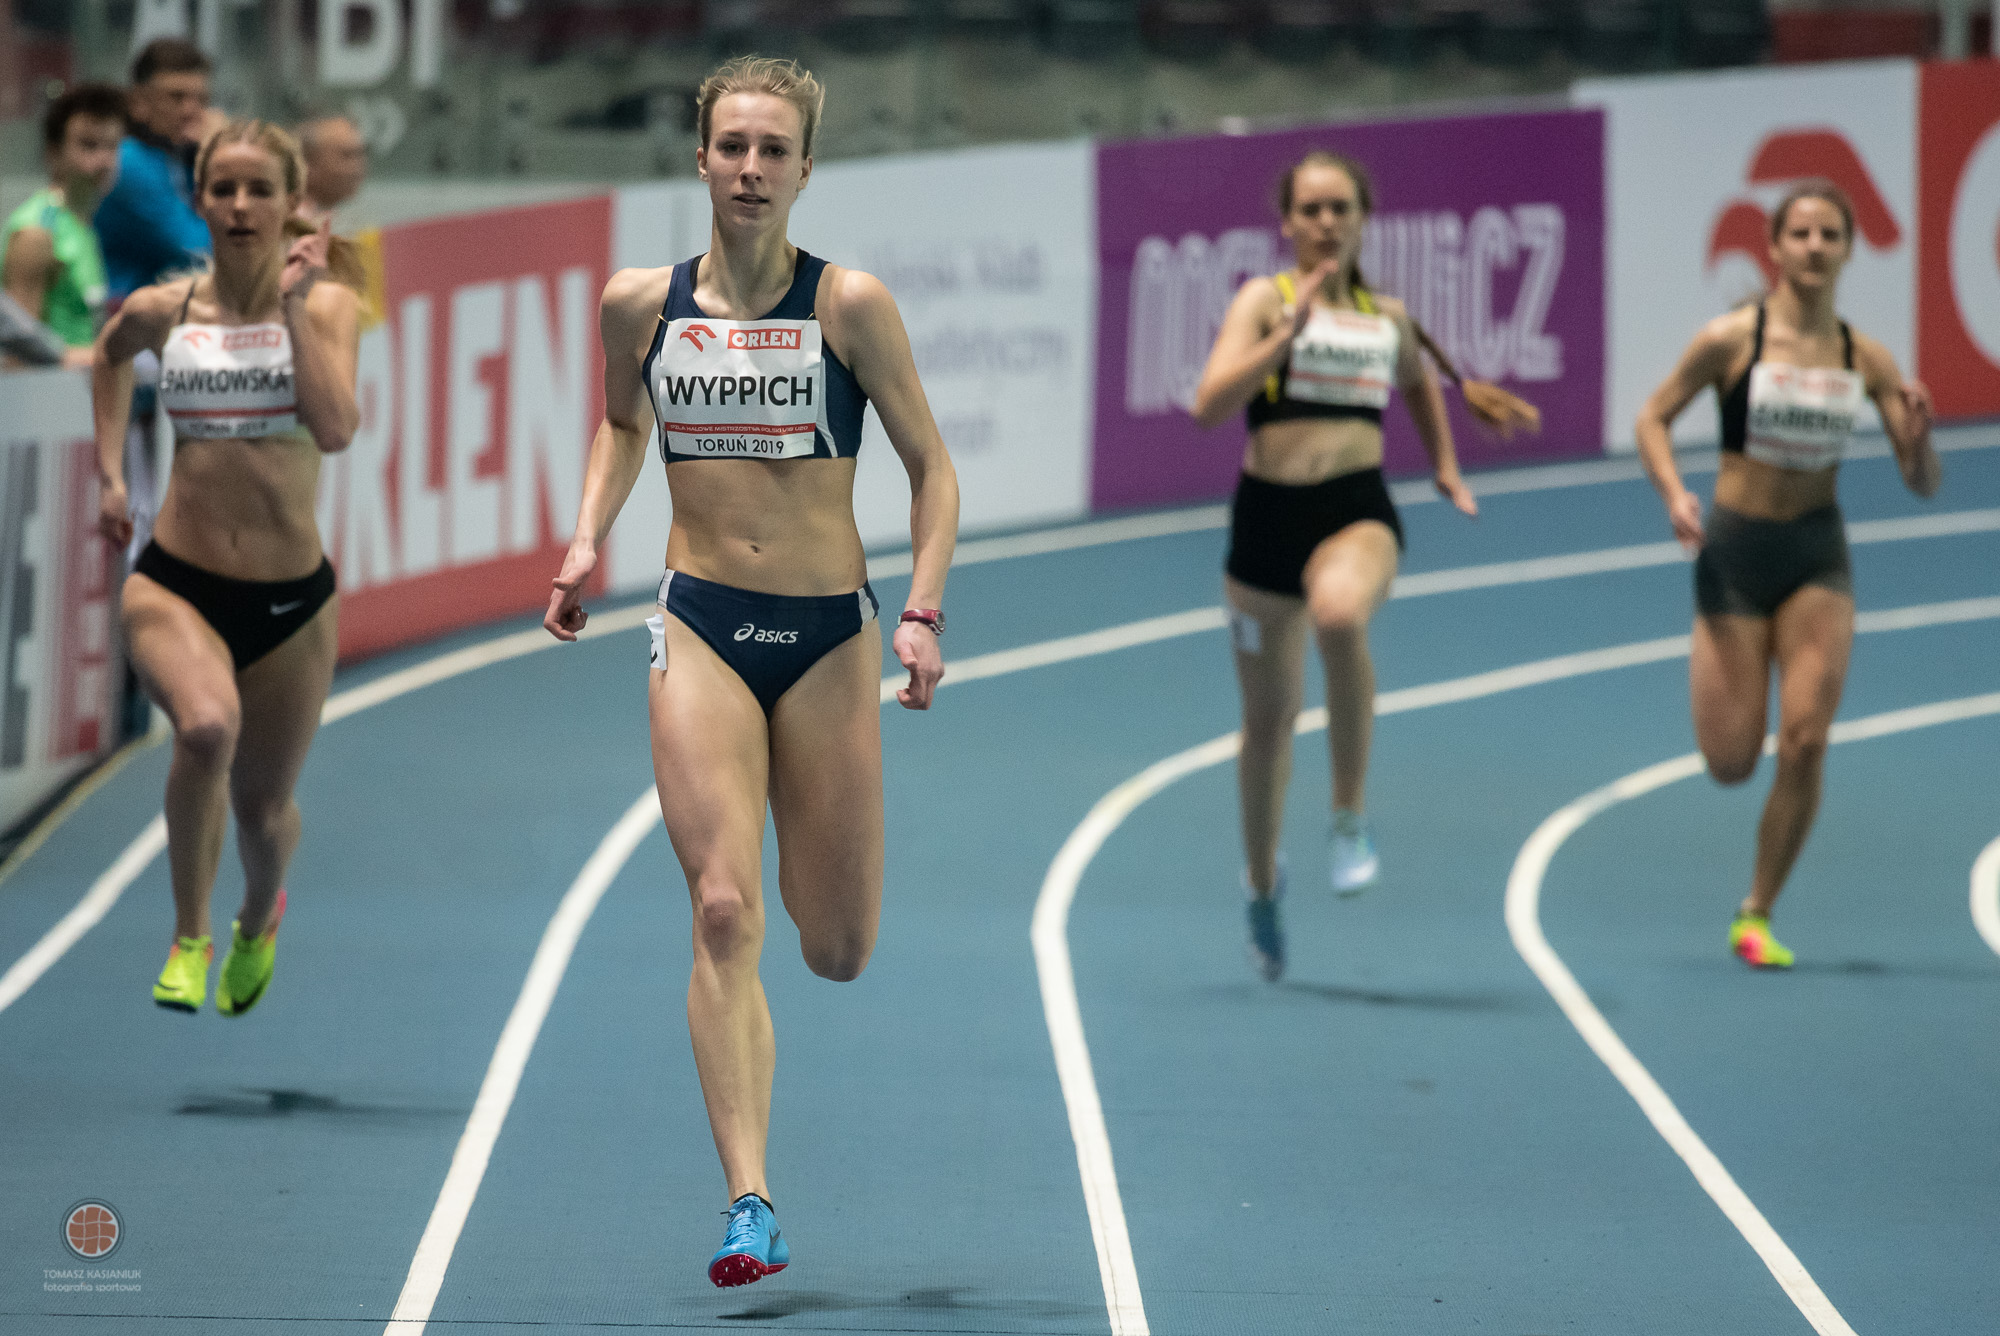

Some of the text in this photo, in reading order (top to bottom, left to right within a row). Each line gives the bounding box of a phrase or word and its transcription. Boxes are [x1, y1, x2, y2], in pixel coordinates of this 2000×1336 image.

[731, 331, 797, 347] ORLEN
[665, 375, 813, 406] WYPPICH
[316, 268, 597, 592] RLEN
[695, 434, 784, 454] TORUŃ 2019
[754, 629, 799, 644] asics
